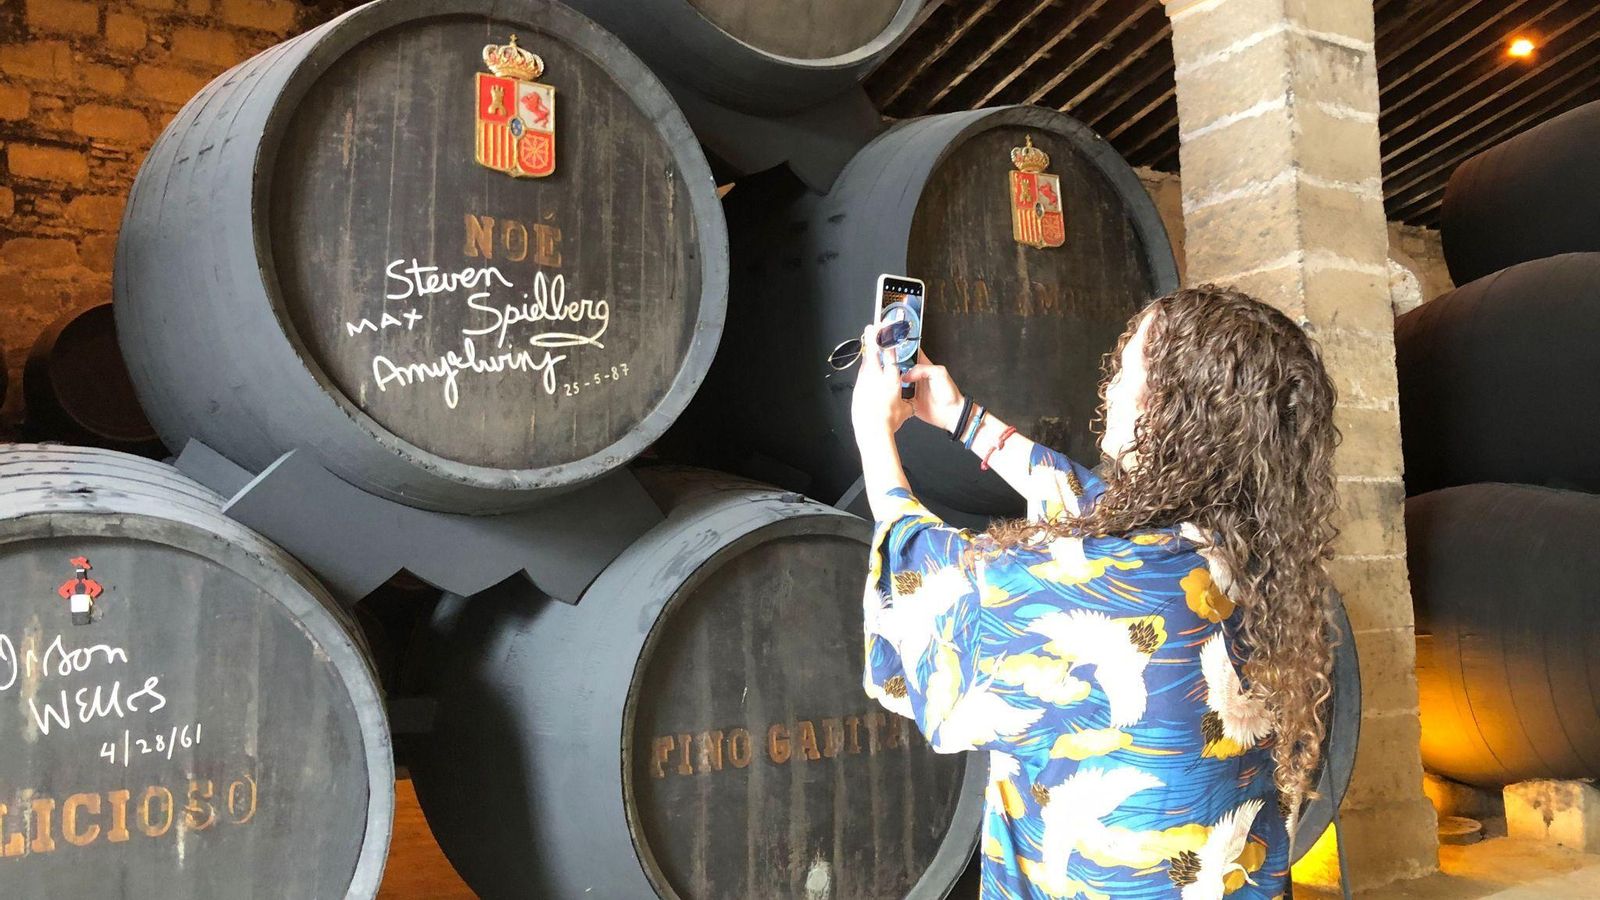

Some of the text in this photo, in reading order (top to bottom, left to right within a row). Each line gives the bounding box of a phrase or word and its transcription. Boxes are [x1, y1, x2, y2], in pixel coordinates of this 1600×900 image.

[463, 212, 562, 268] NOÉ
[385, 257, 514, 300] Steven
[345, 308, 424, 337] MAX
[461, 270, 610, 349] Spielberg
[100, 723, 201, 768] 4/28/61
[651, 712, 925, 779] FINO GADITA
[0, 773, 258, 858] LICIOSO
